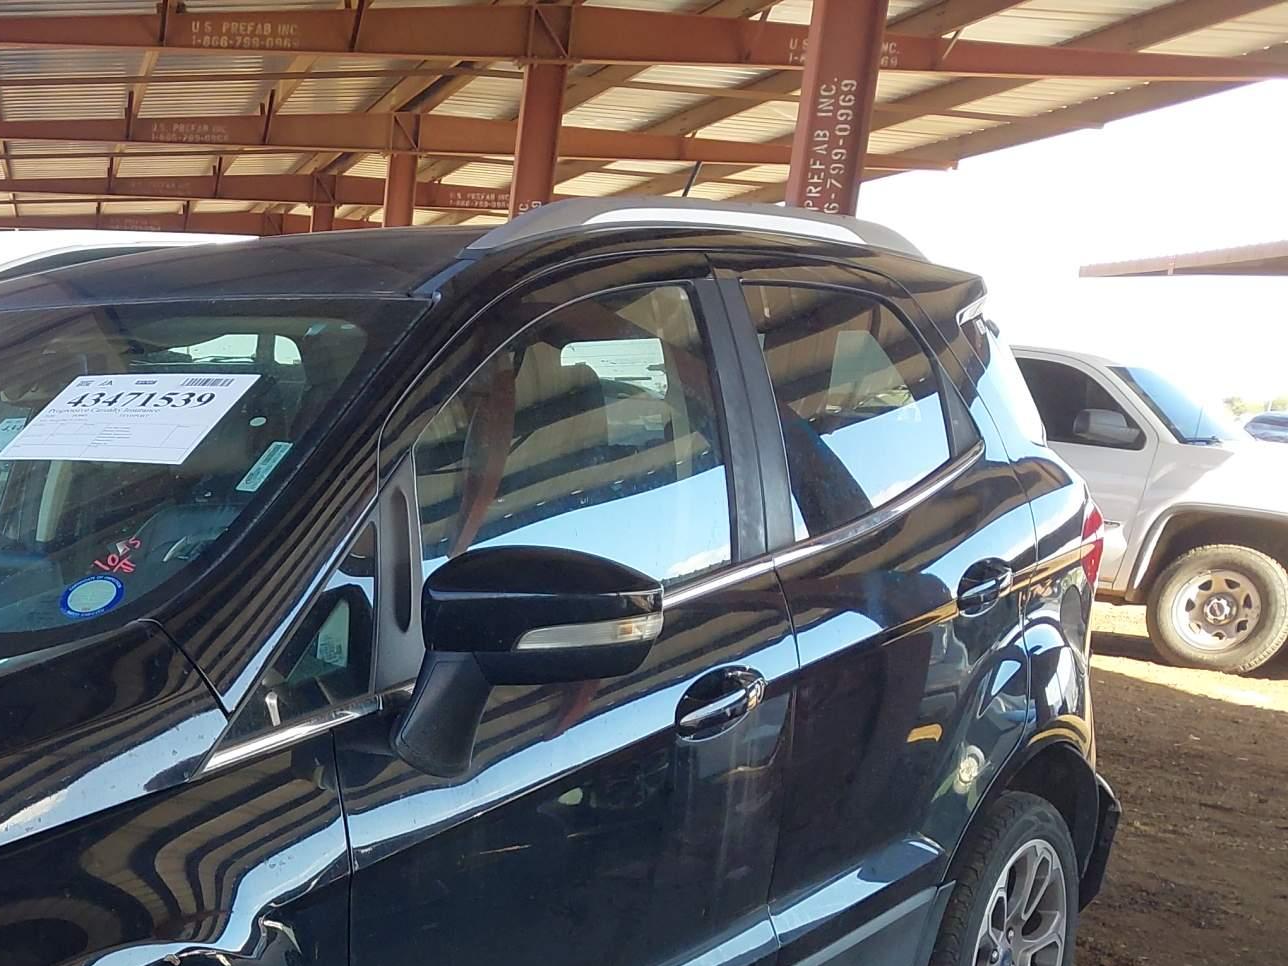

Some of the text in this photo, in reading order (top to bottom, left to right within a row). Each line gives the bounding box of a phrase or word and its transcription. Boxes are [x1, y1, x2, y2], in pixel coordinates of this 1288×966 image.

[222, 21, 272, 35] PREFAB
[817, 77, 838, 116] INC.
[804, 129, 831, 211] PREFAB
[67, 391, 216, 409] 43471539
